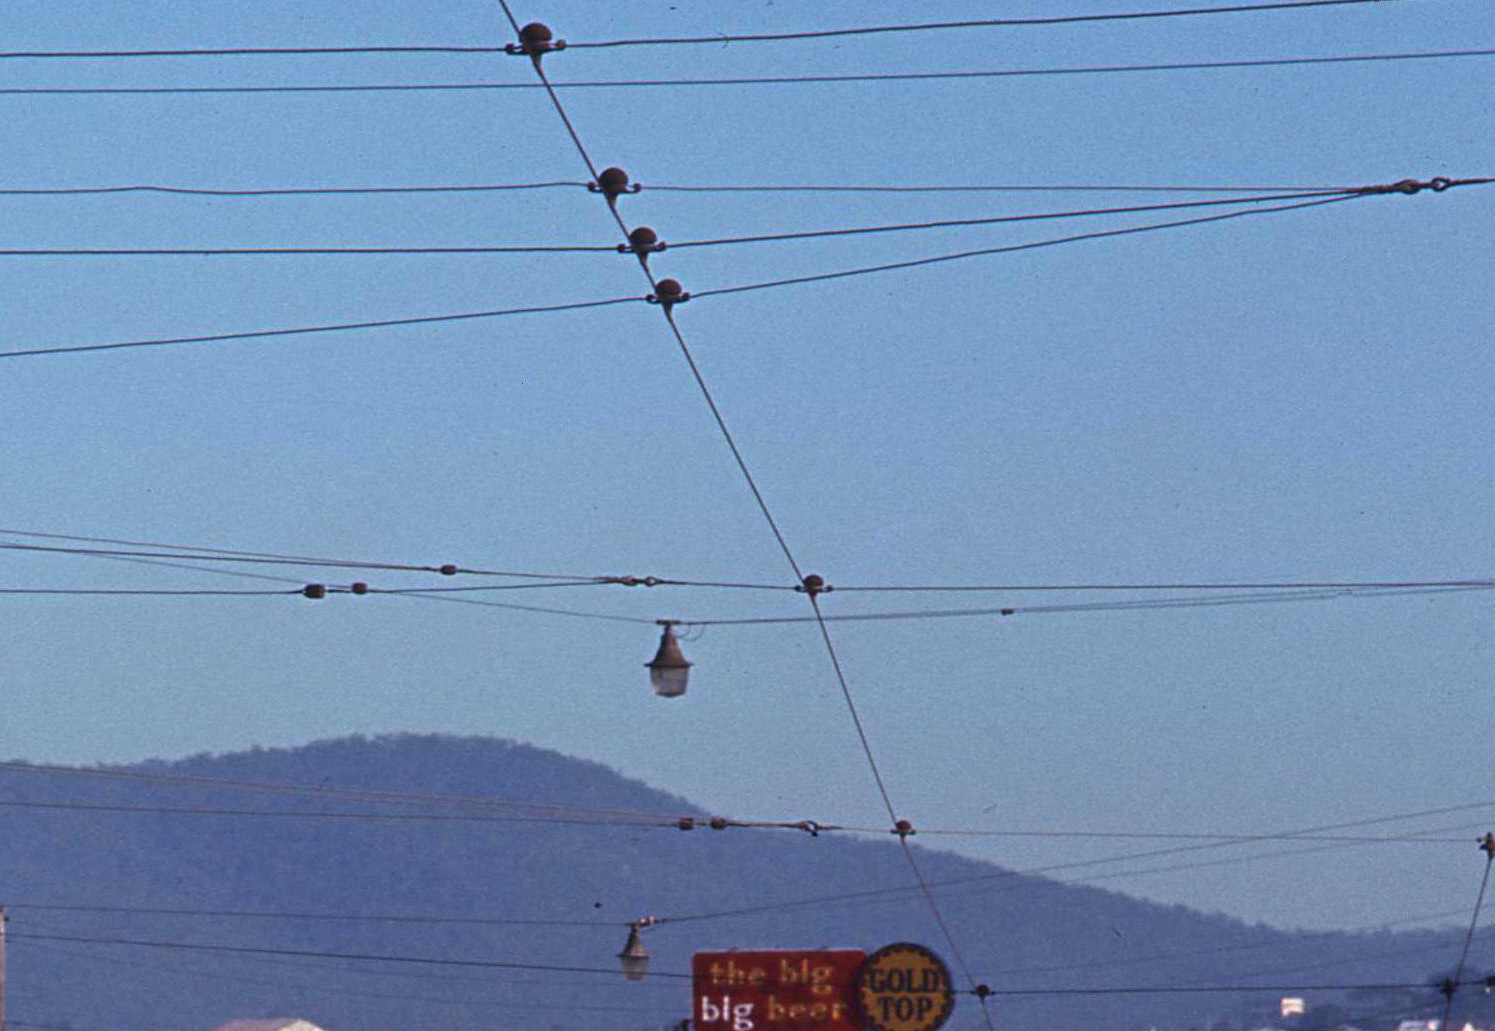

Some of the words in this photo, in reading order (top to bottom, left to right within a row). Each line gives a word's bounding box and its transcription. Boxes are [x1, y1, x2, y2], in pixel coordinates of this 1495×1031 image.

[710, 960, 767, 985] the
[869, 967, 940, 993] GOLD
[701, 994, 755, 1031] big
[767, 994, 847, 1021] beer
[876, 996, 933, 1021] TOP
